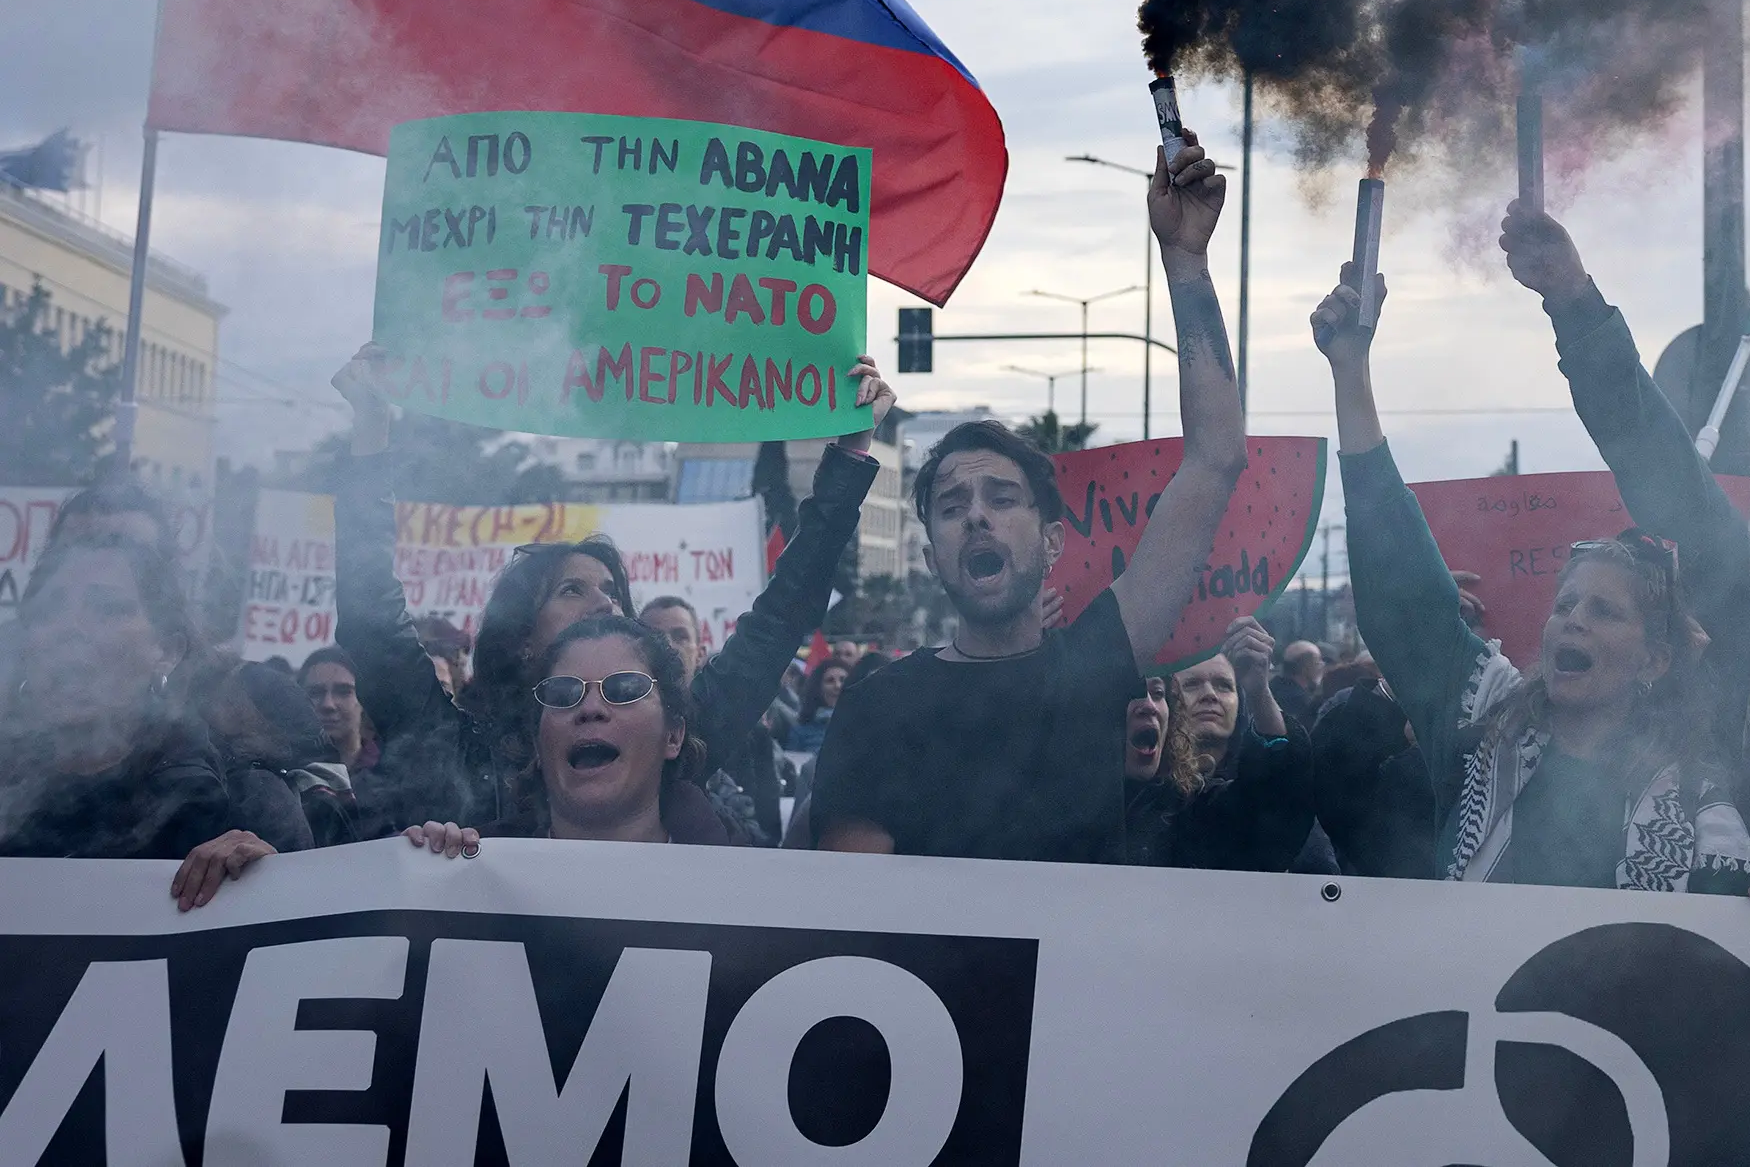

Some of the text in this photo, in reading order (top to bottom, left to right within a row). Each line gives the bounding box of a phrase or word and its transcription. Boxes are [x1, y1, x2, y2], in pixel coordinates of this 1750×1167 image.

[423, 131, 860, 214] ΑΠΟ ΤΗΝ ΑΒΑΝΑ
[386, 202, 863, 276] ΜΕΧΡΙ ΤΗΝ ΤΕΧΕΡΑΝΗ
[684, 272, 837, 335] ΝΑΤΟ
[478, 357, 531, 407] ΟΙ
[561, 341, 837, 412] ΑΜΕΡΙΚΑΝΟΙ
[690, 547, 733, 581] ΤΩΝ
